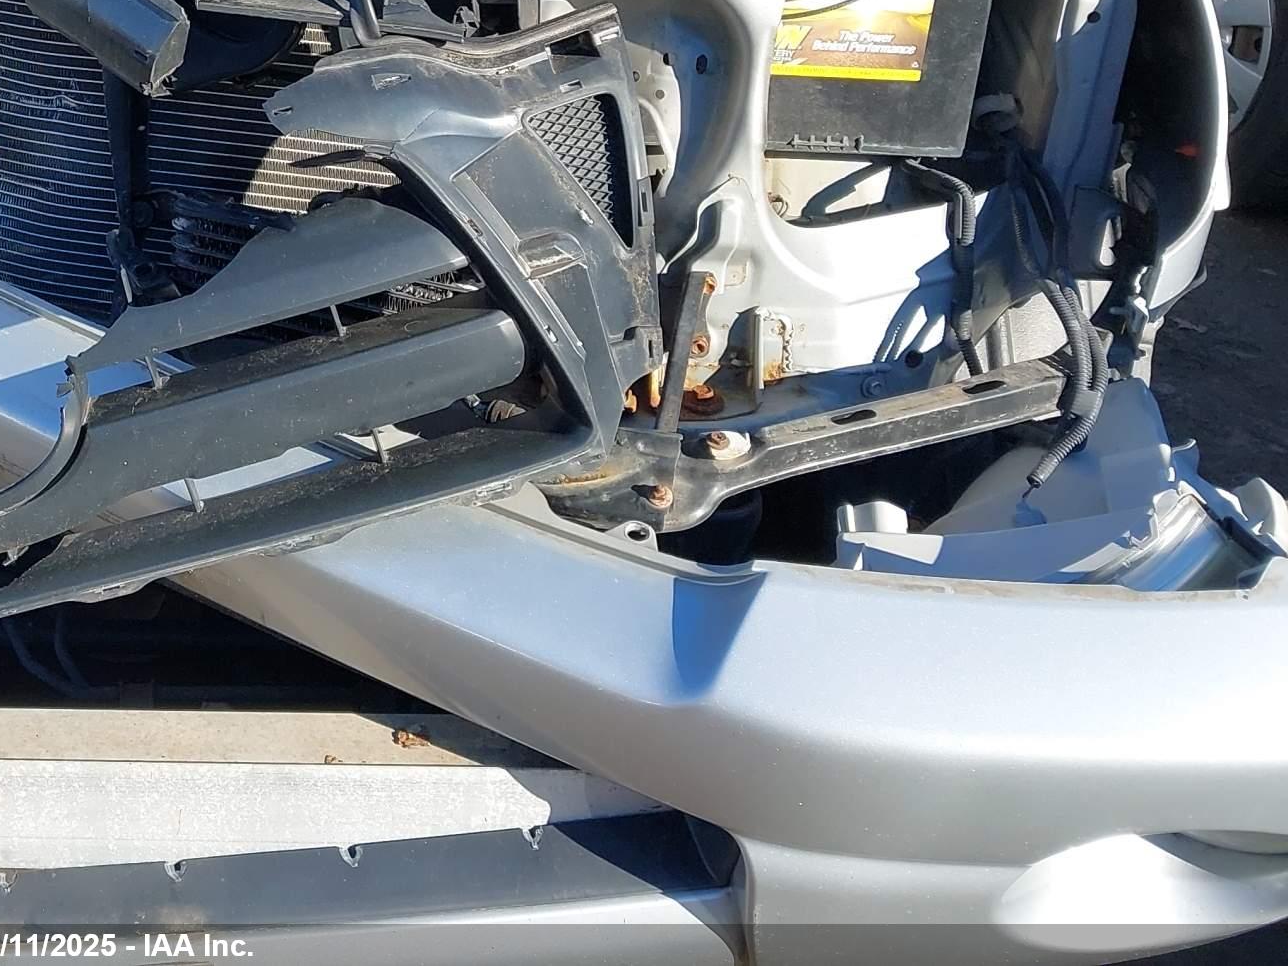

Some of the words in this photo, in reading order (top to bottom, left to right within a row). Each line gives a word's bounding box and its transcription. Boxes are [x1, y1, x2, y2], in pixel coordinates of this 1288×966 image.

[839, 30, 859, 42] The
[860, 31, 895, 43] Power
[812, 39, 849, 52] Behind
[848, 42, 917, 55] Performance
